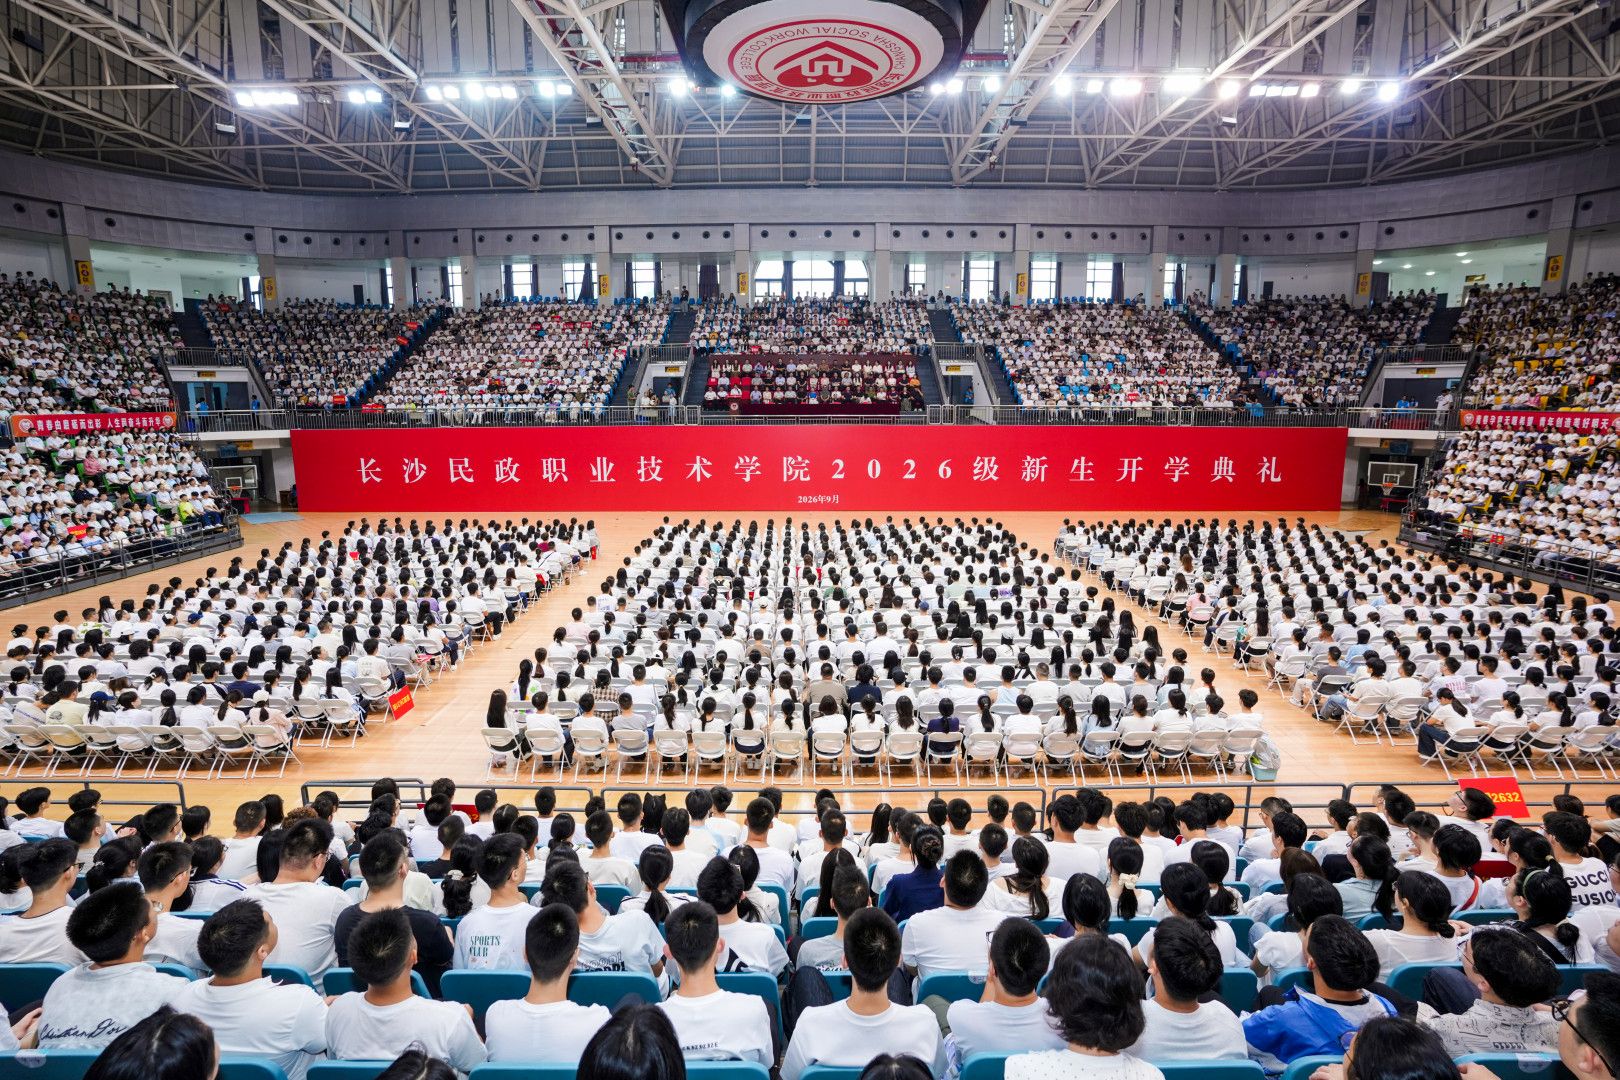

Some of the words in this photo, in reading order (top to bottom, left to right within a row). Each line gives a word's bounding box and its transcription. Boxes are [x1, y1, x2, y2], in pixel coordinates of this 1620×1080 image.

[768, 28, 809, 43] WORK
[812, 26, 870, 38] SOCIAL
[741, 40, 768, 70] COLLEGE
[874, 34, 905, 70] CHANGSHA
[357, 456, 1283, 484] 长沙民政职业技术学院2026级新生开学典礼
[797, 494, 840, 504] 2026年9月
[470, 935, 501, 945] SPORTS
